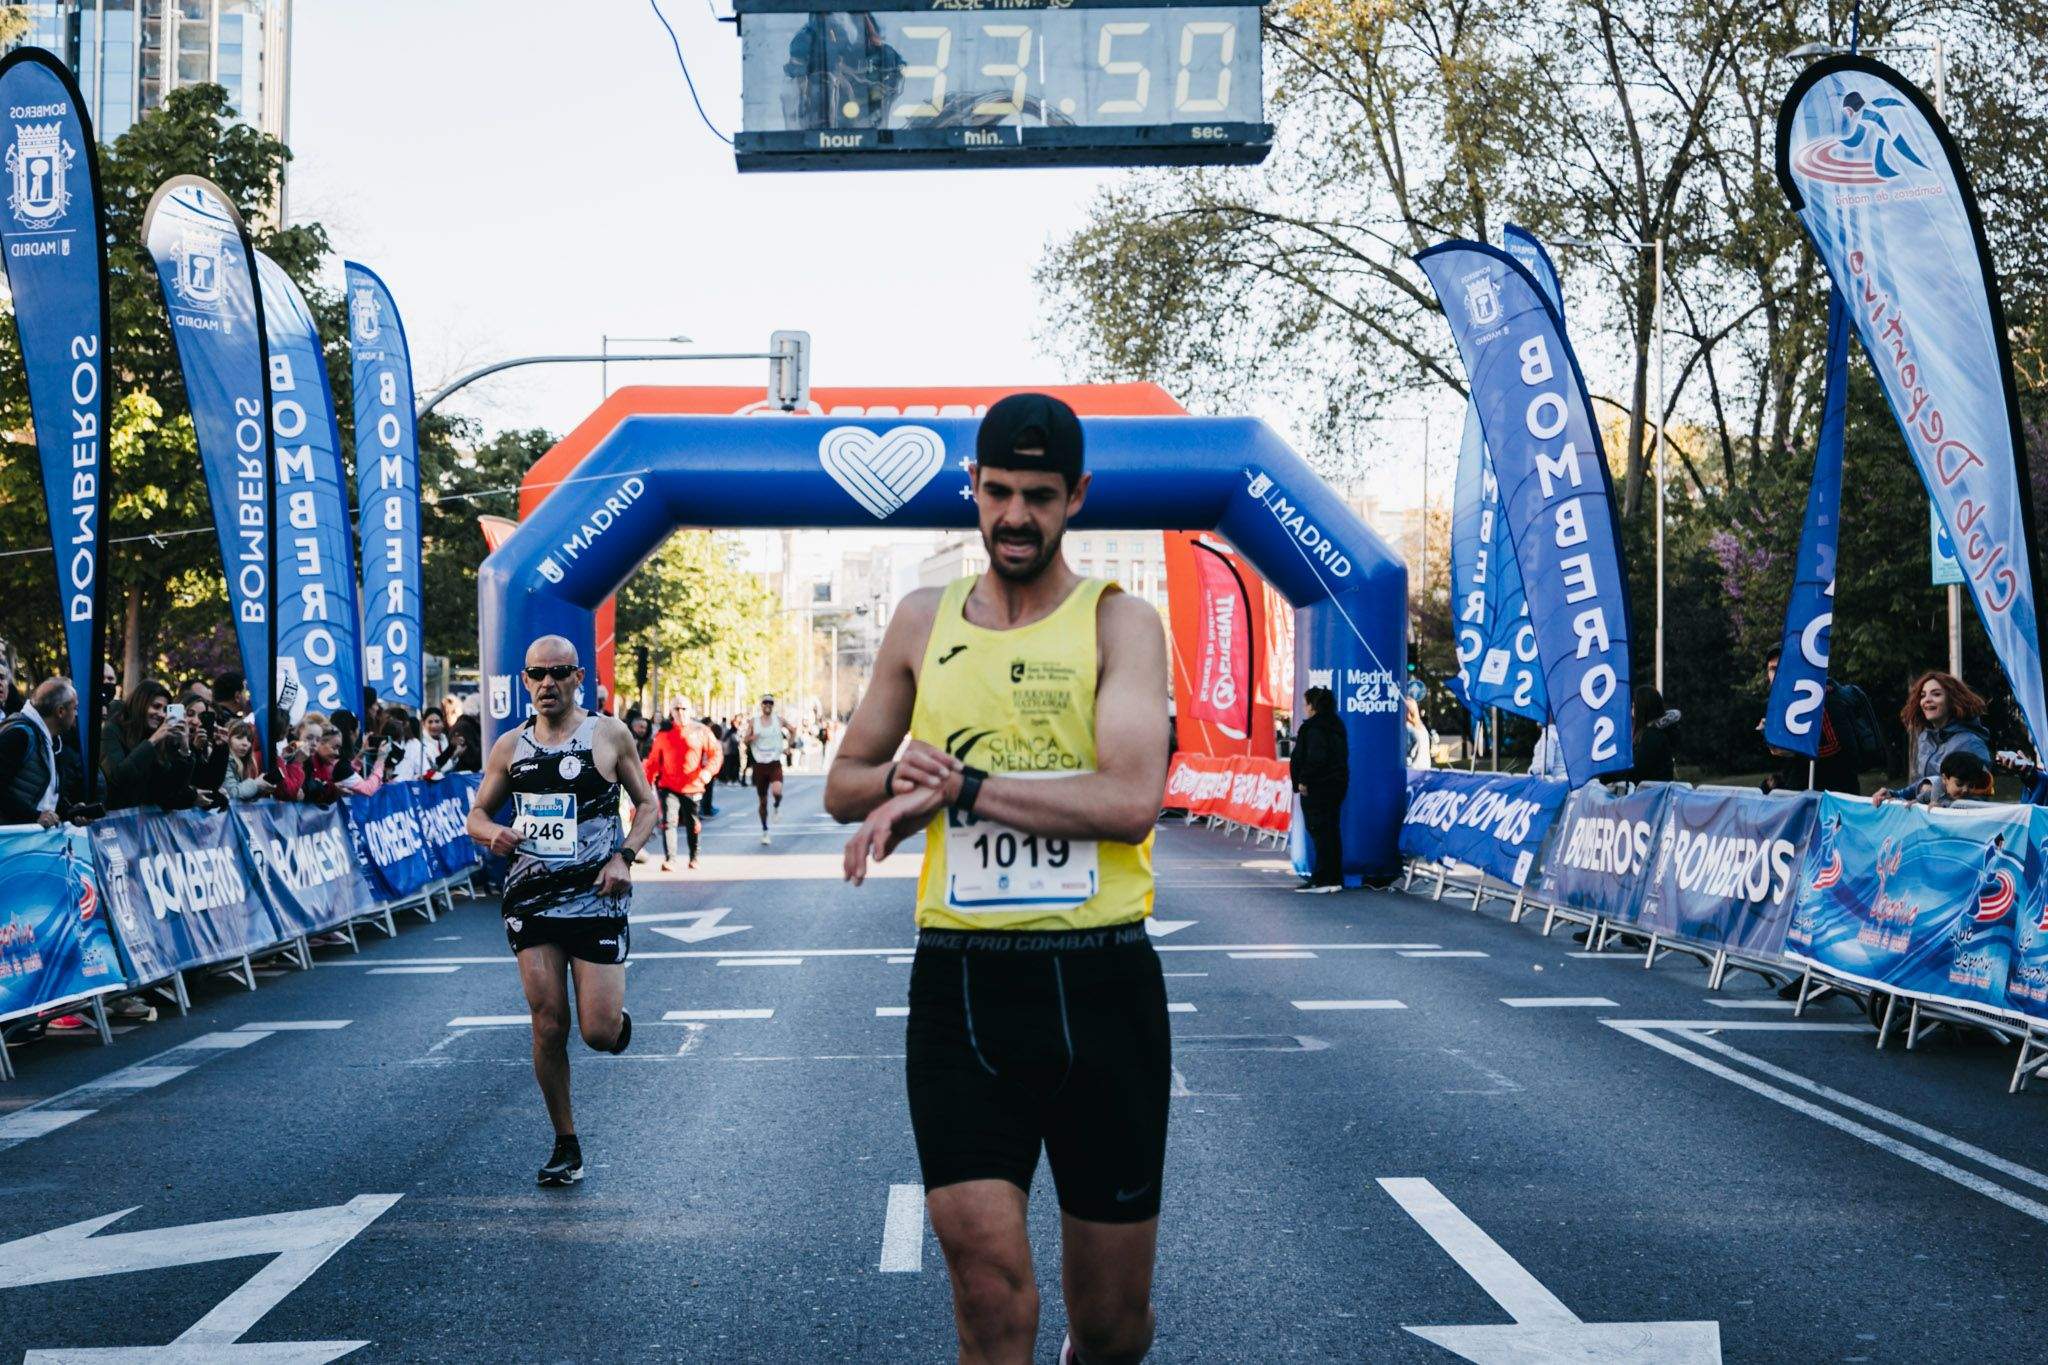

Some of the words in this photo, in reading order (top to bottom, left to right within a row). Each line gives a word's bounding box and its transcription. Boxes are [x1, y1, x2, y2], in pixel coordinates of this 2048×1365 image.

[819, 132, 864, 148] hour
[964, 130, 1003, 146] min.
[1191, 125, 1228, 139] sec.
[563, 477, 645, 560] MADRID
[1273, 497, 1351, 579] MADRID
[1347, 669, 1393, 684] Madrid
[1356, 683, 1381, 701] es
[1346, 696, 1399, 715] Deporte
[523, 822, 564, 841] 1246
[974, 832, 1070, 869] 1019
[1674, 828, 1795, 906] BOMBEROS
[966, 936, 1010, 951] PRO
[1015, 934, 1106, 951] COMBAT
